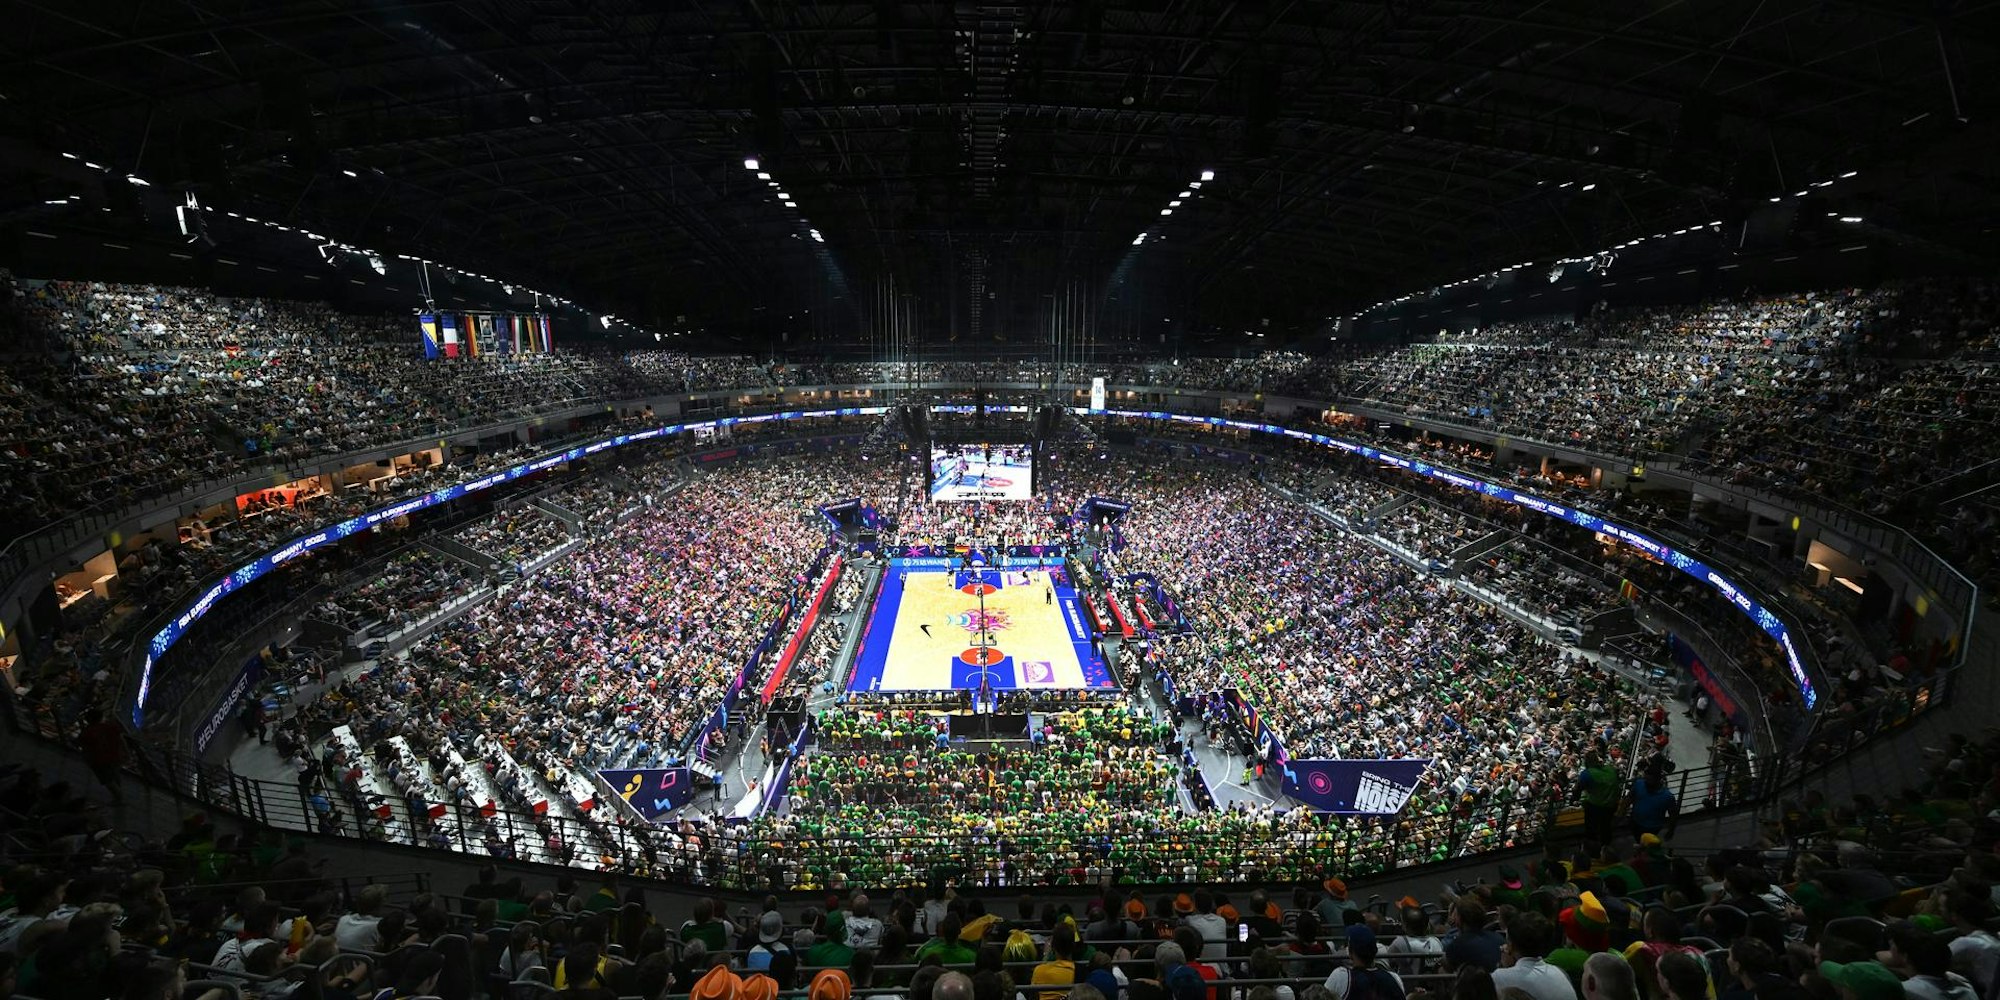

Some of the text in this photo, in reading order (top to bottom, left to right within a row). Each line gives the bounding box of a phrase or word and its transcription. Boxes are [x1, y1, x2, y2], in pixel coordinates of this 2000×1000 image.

[366, 499, 424, 524] FIBA EUROBASKET
[1513, 494, 1566, 516] GERMANY 2022
[271, 532, 327, 564] GERMANY 2022
[1602, 524, 1661, 554] FIBA EUROBASKET
[1028, 558, 1053, 566] WADA
[1707, 572, 1752, 611] GERMANY 2022
[178, 584, 223, 630] FIBA EUROBASKET
[198, 672, 249, 753] #EUROBASKET
[1361, 771, 1412, 792] BRING THE
